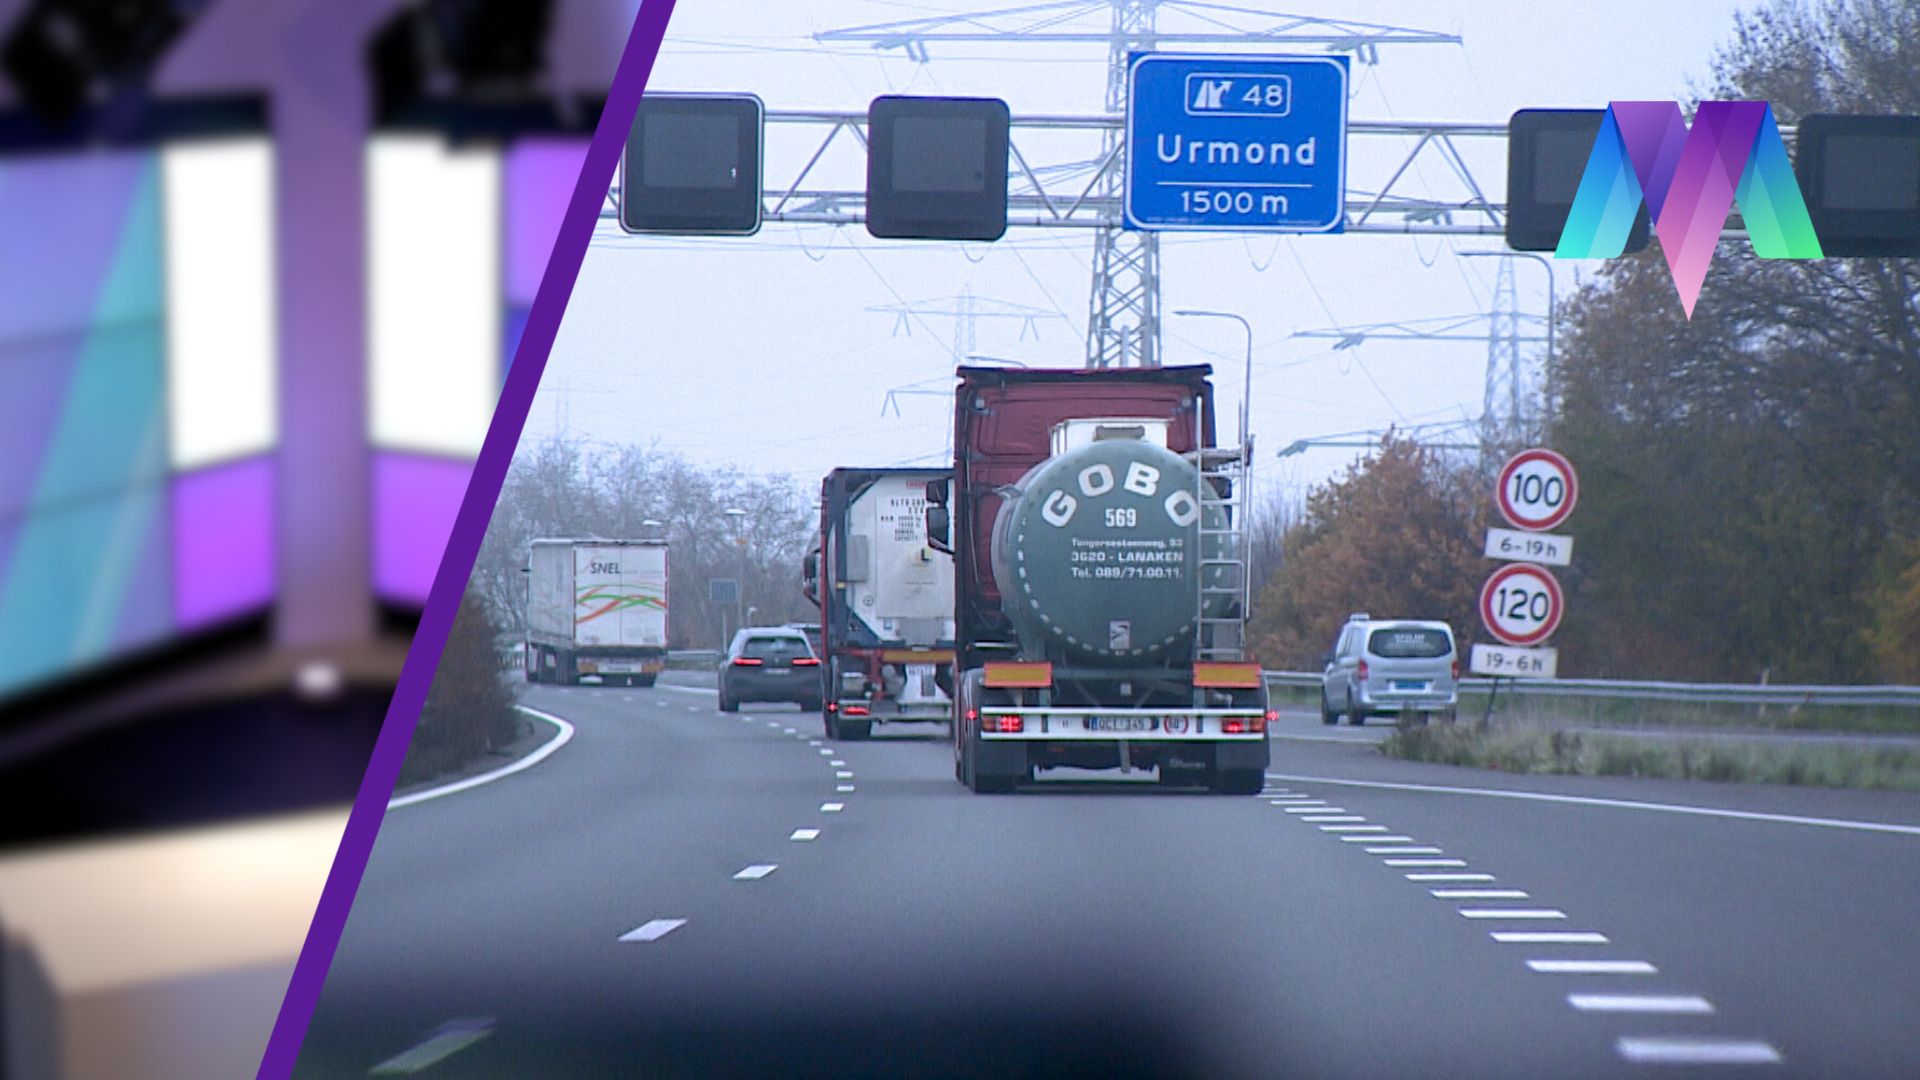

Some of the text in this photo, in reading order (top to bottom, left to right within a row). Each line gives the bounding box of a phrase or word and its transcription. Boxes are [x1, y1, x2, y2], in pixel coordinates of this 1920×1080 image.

[1242, 84, 1283, 107] 48
[1157, 133, 1316, 165] Urmond
[1181, 191, 1288, 214] 1500 m
[1041, 461, 1199, 527] GOBO
[1514, 473, 1564, 507] 100
[1105, 508, 1137, 527] 569
[590, 562, 621, 574] SNEL
[1071, 551, 1106, 561] 3620
[1118, 551, 1184, 562] LANAKEN
[1071, 567, 1092, 578] Tel.
[1498, 588, 1549, 621] 120
